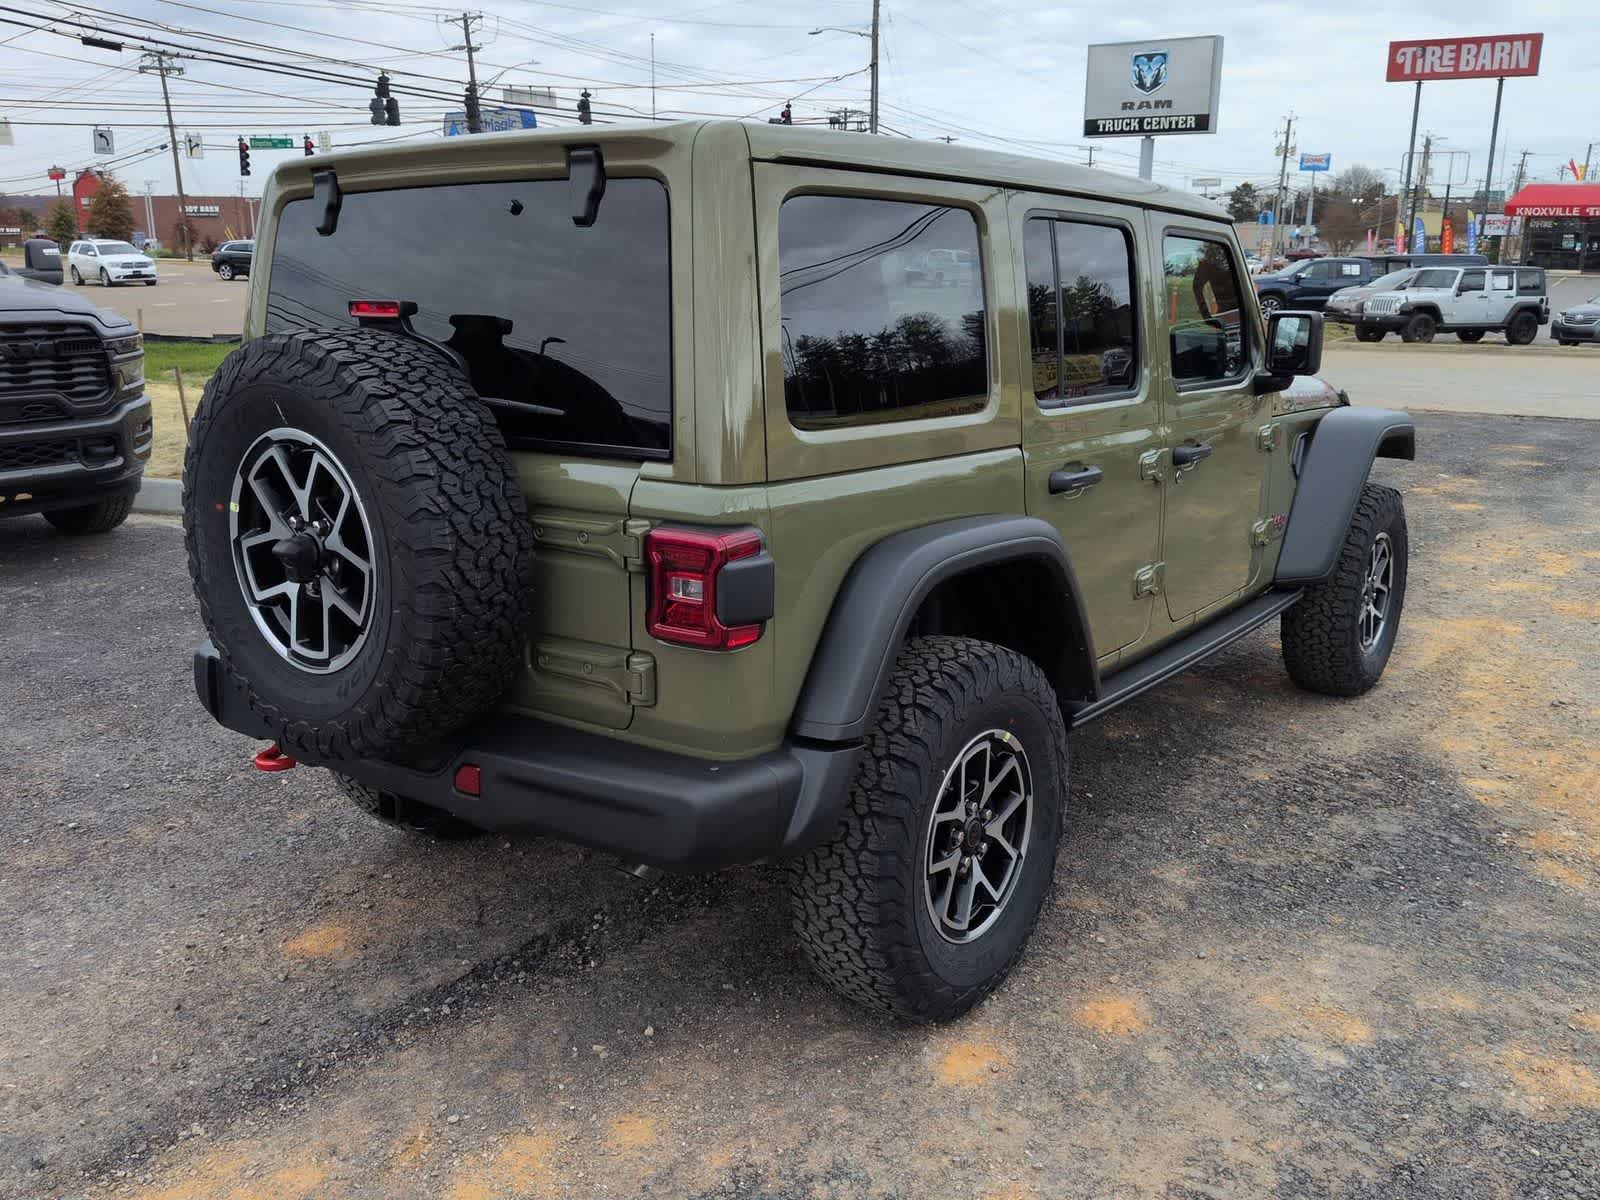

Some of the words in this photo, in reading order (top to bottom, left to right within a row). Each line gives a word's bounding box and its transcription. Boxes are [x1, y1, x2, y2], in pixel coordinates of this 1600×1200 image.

[1459, 40, 1532, 72] BARN
[1121, 100, 1173, 110] RAM
[1097, 118, 1139, 132] TRUCK
[1143, 116, 1196, 130] CENTER
[1515, 207, 1580, 216] KNOXVILLE
